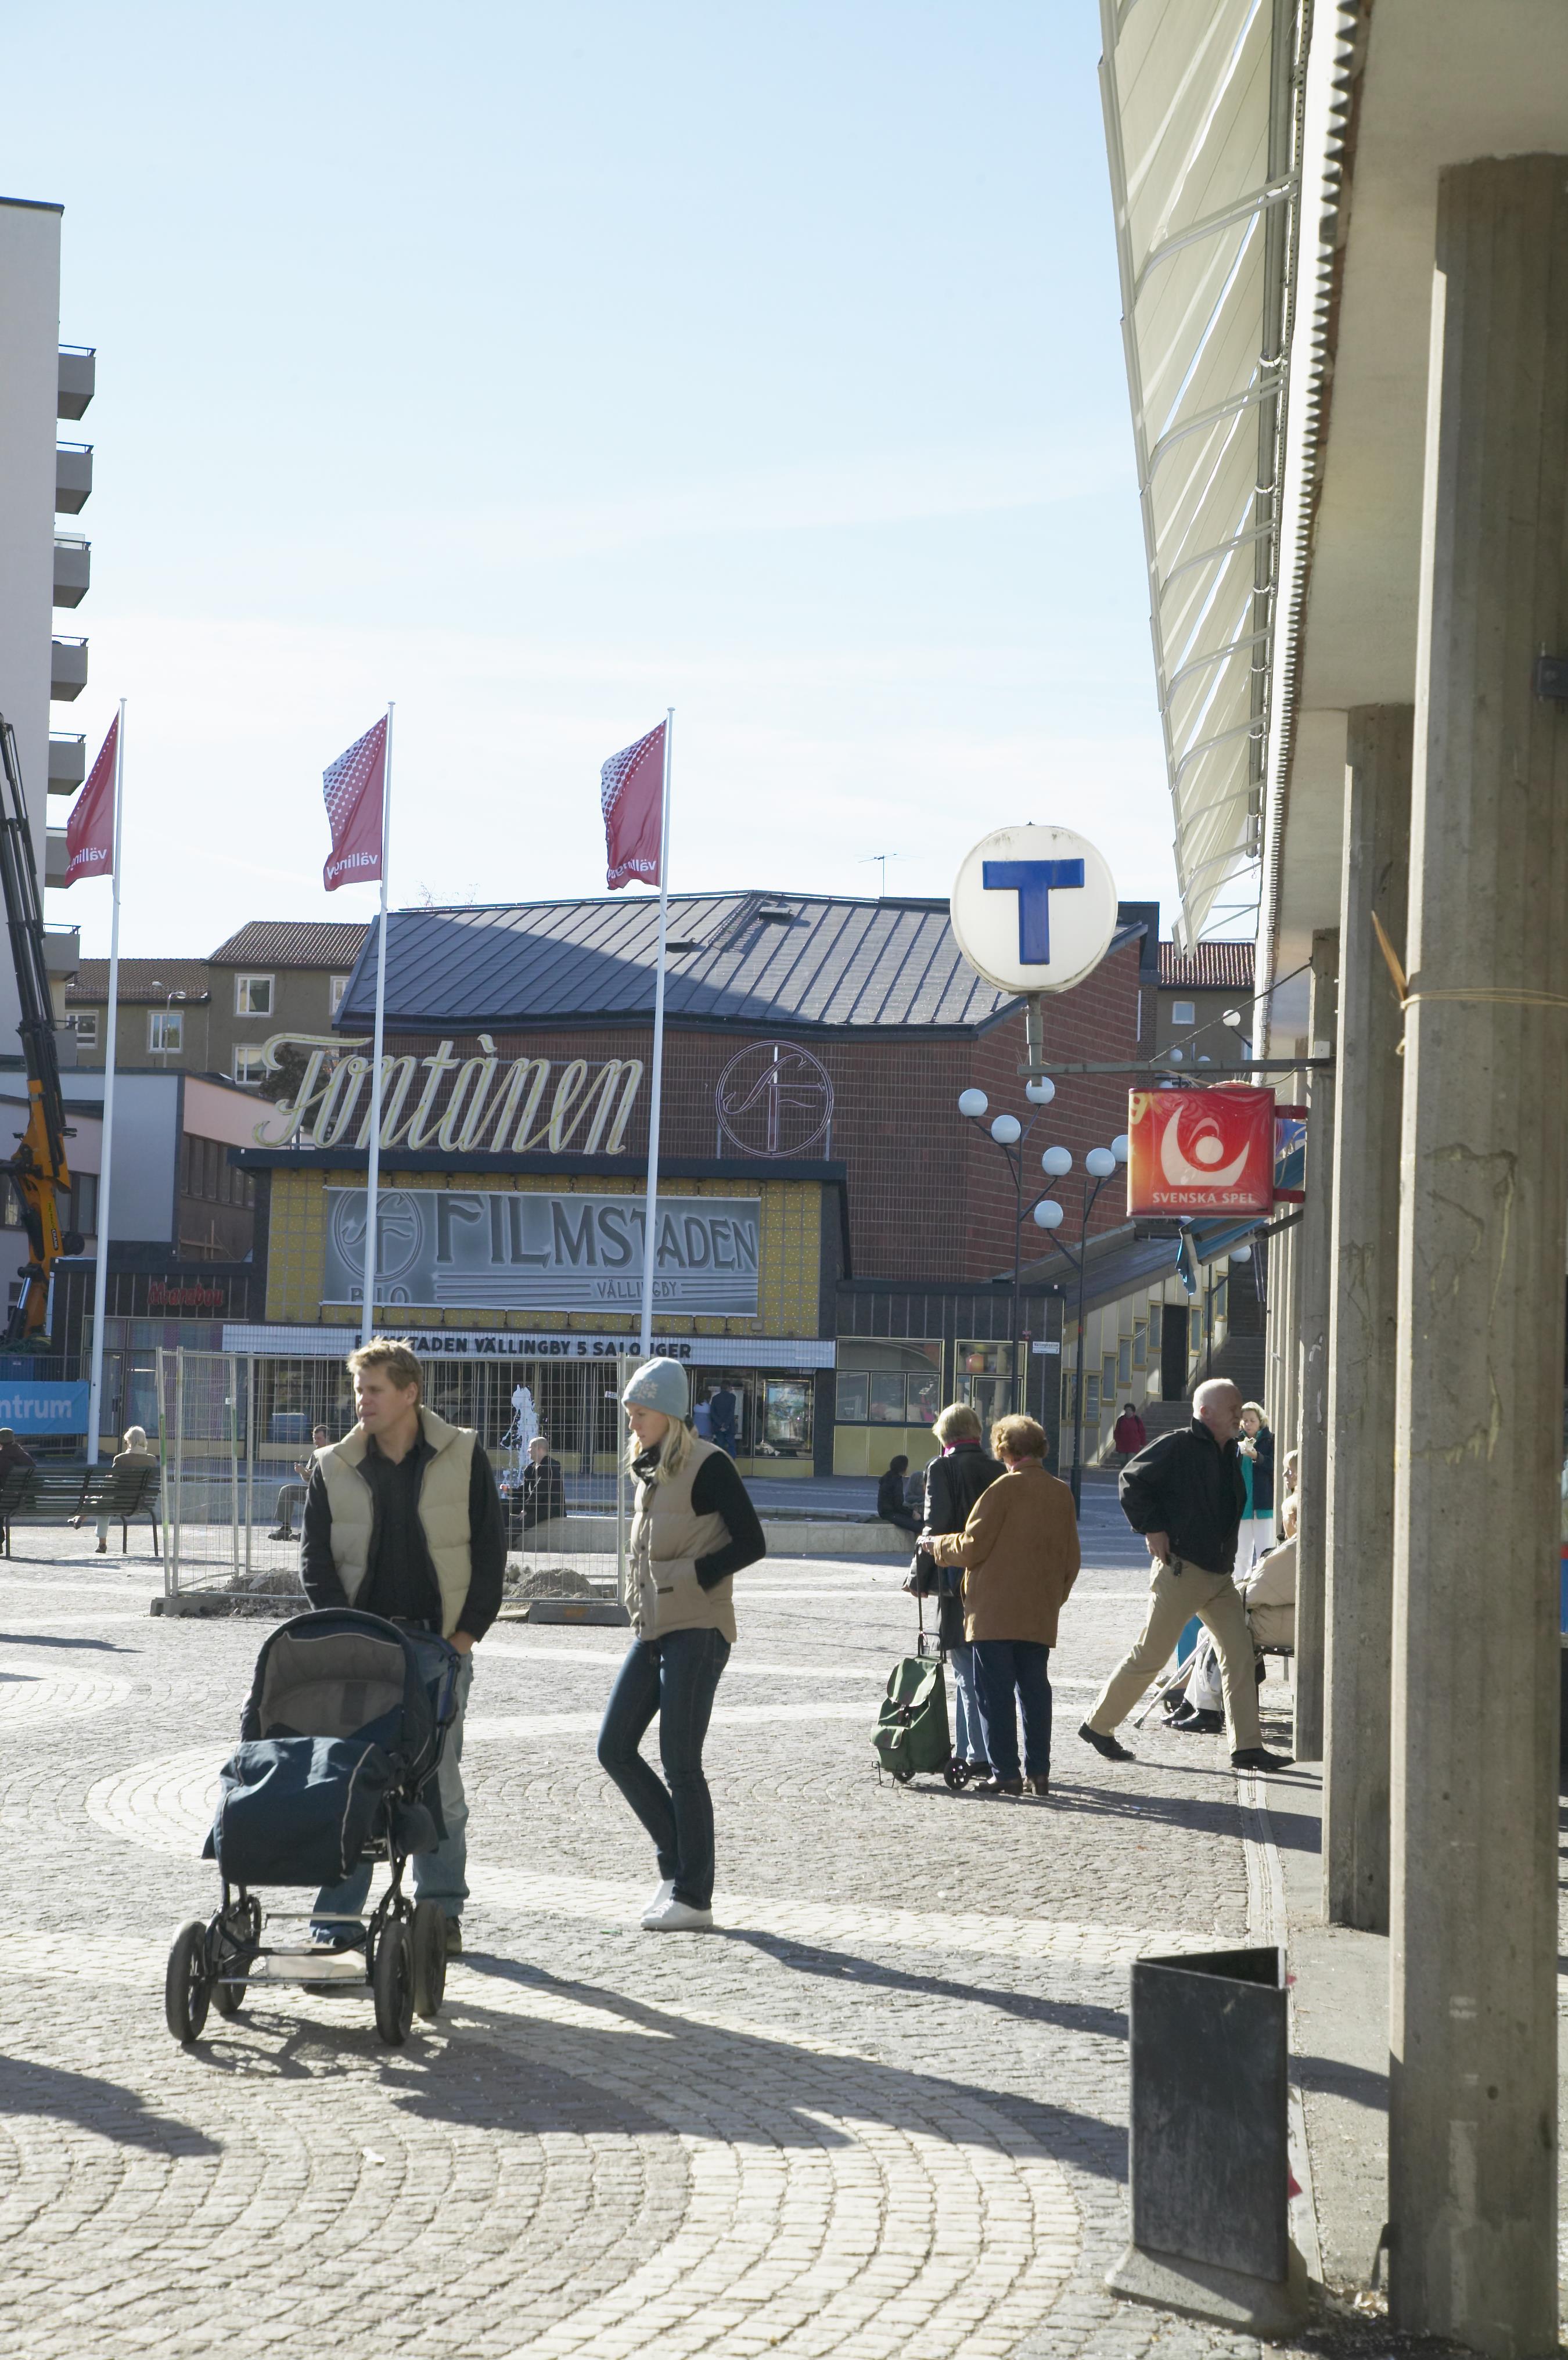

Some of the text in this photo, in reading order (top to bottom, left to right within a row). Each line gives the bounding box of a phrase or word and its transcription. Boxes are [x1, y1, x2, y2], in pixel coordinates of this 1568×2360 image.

[983, 858, 1085, 965] T
[1152, 1192, 1256, 1204] SVENSKA SPEL
[436, 1193, 758, 1271] FILMSTADEN
[597, 1279, 677, 1298] VÄLLIGBY
[355, 1335, 692, 1358] FTADEN VÄLLINGBY 5 SALOGER
